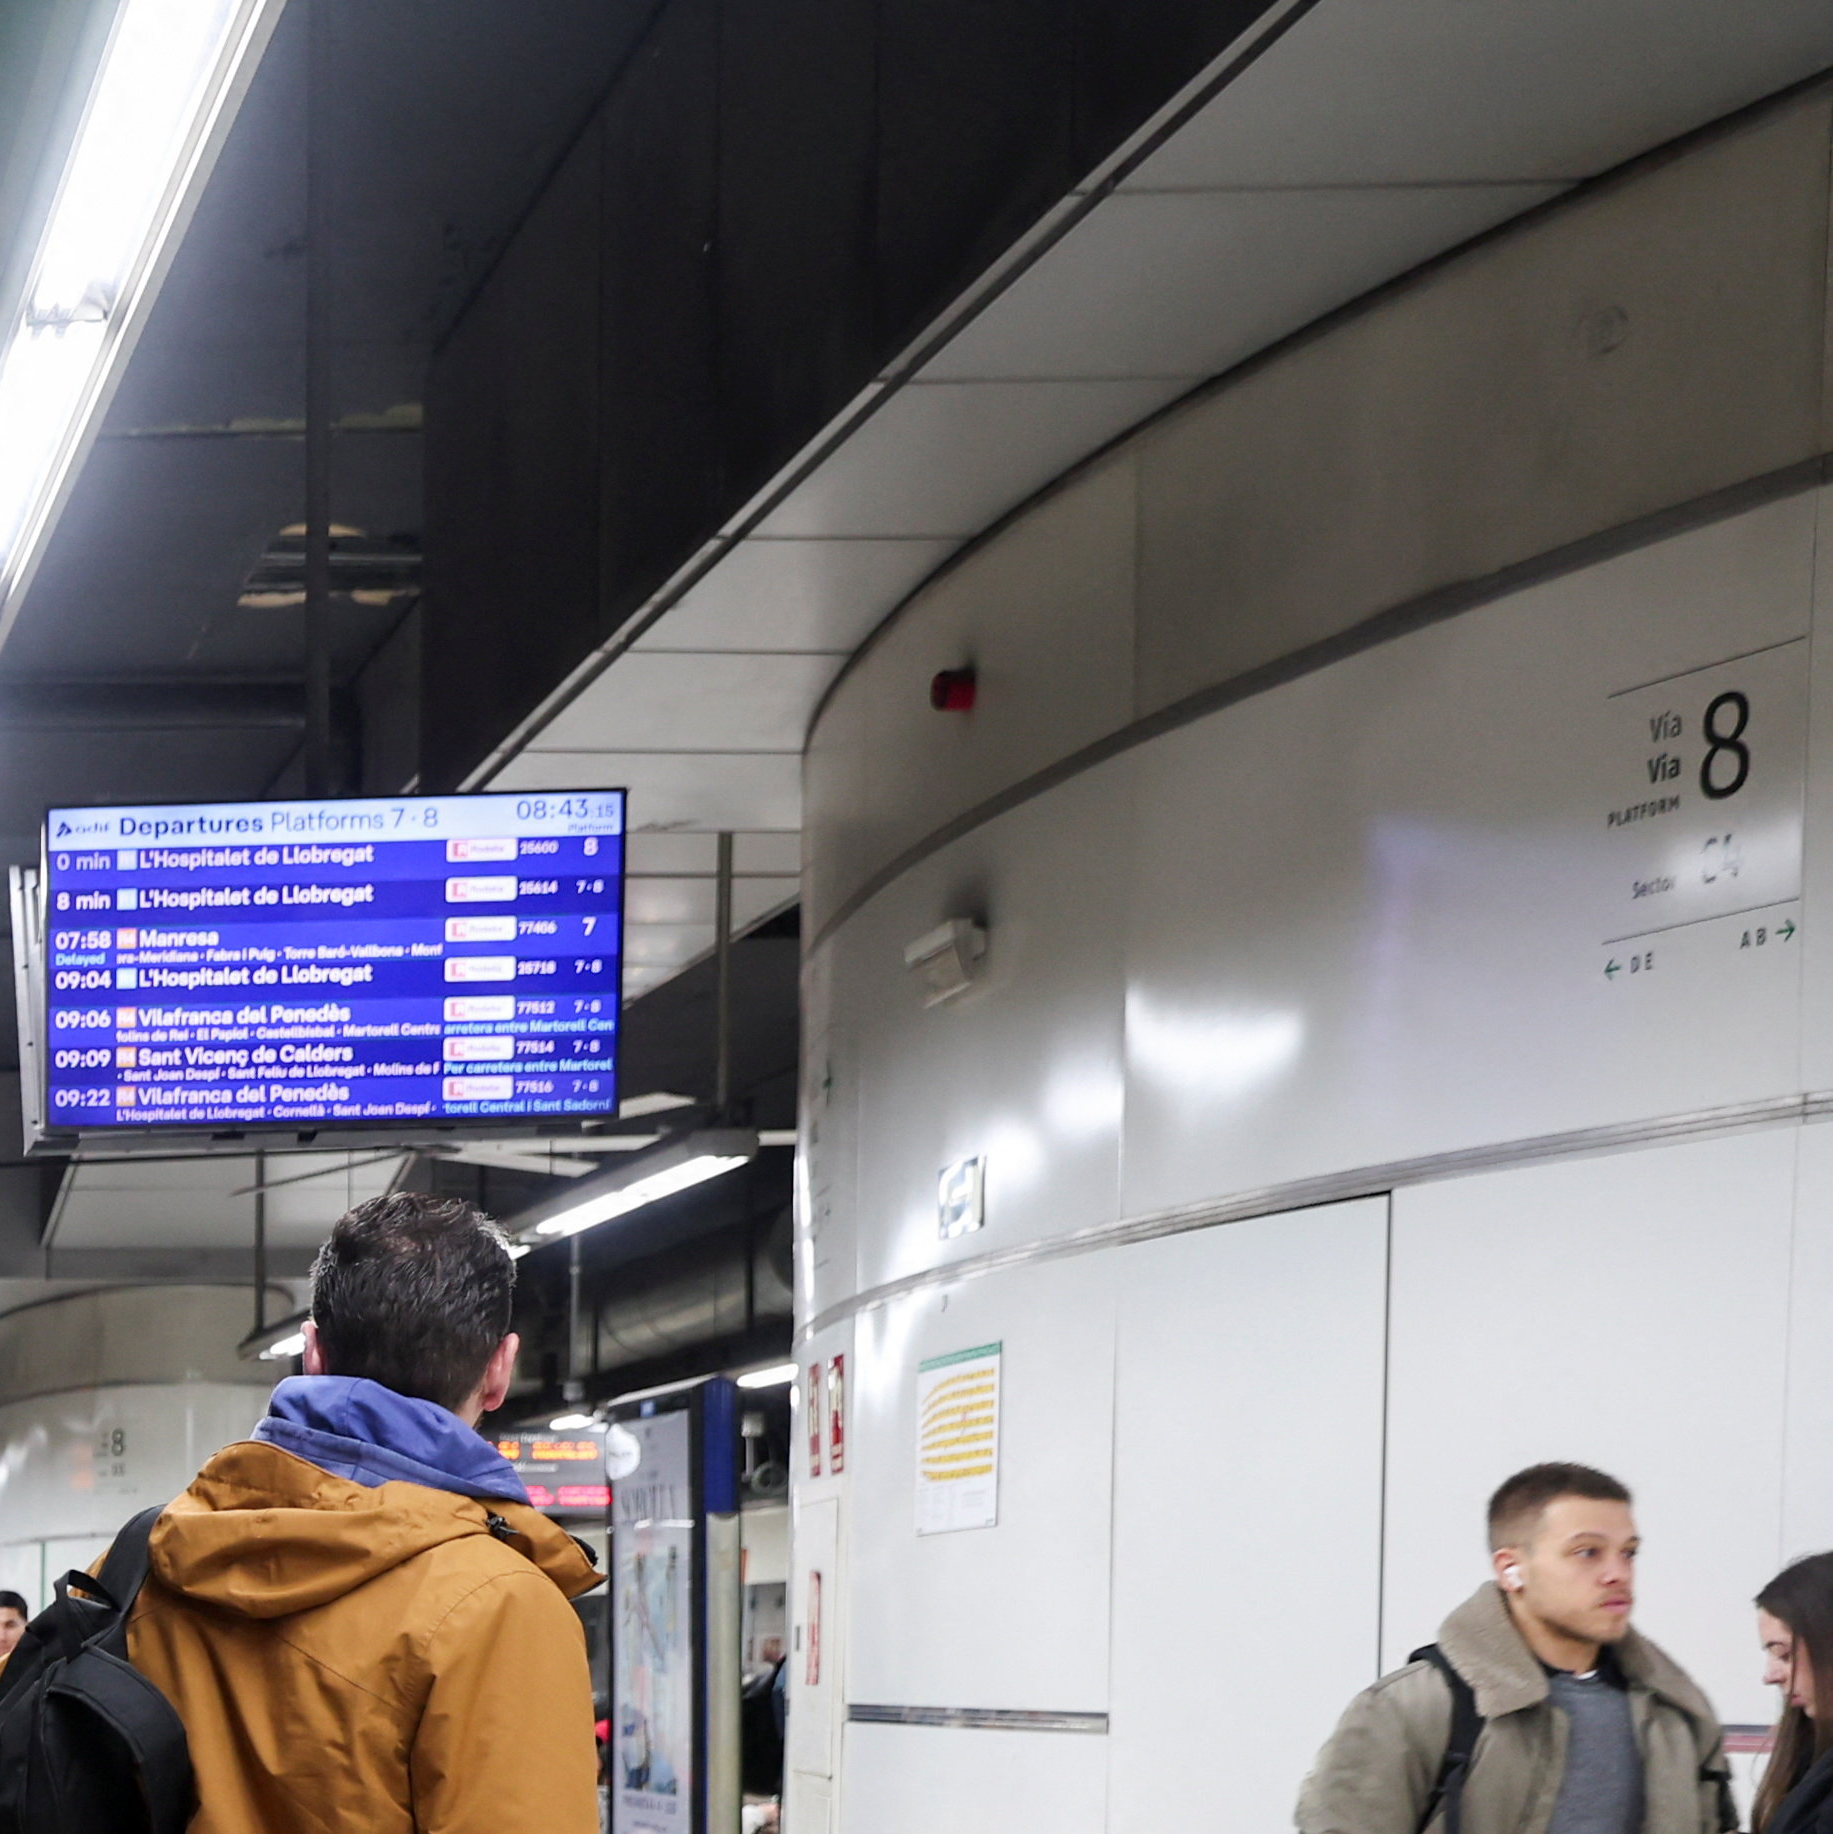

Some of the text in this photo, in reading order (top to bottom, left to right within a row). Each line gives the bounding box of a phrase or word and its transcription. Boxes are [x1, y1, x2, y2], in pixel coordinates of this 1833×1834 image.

[1649, 709, 1683, 743] Vía
[1699, 690, 1750, 801] 8
[1607, 795, 1680, 829] PLATFORM
[120, 813, 263, 840] Departures
[271, 809, 383, 832] Platforms
[392, 809, 404, 828] 7
[423, 807, 437, 827] 8
[582, 836, 598, 855] 8
[56, 853, 70, 870] 0
[75, 851, 110, 870] min
[139, 847, 250, 872] L'Hospitalet
[253, 846, 279, 865] de
[282, 843, 374, 868] Llobregat
[56, 892, 70, 910] 8
[75, 890, 110, 910] min
[139, 886, 250, 911] L'Hospitalet
[253, 886, 279, 905] de
[282, 883, 373, 908] Llobregat
[582, 916, 596, 936] 7
[55, 930, 111, 950] 07:58
[139, 927, 219, 948] Manresa
[55, 952, 105, 967] Delayed
[55, 970, 111, 989] 09:04
[139, 965, 250, 991] L'Hospitalet
[252, 965, 278, 984] de
[281, 962, 373, 987] Llobregat
[55, 1009, 111, 1028] 09:06
[138, 1002, 350, 1026] Vilafranca del Penedès
[55, 1048, 111, 1068] 09:09
[138, 1042, 353, 1068] Sant Vicenç de Calders
[123, 1069, 151, 1081] Sant
[227, 1066, 255, 1079] Sant
[288, 1064, 305, 1078] de
[306, 1063, 365, 1079] Llobregat
[55, 1088, 111, 1107] 09:22
[138, 1081, 349, 1105] Vilafranca del Penedès
[188, 1107, 205, 1120] de
[206, 1105, 264, 1121] Llobregat
[332, 1103, 361, 1116] Sant
